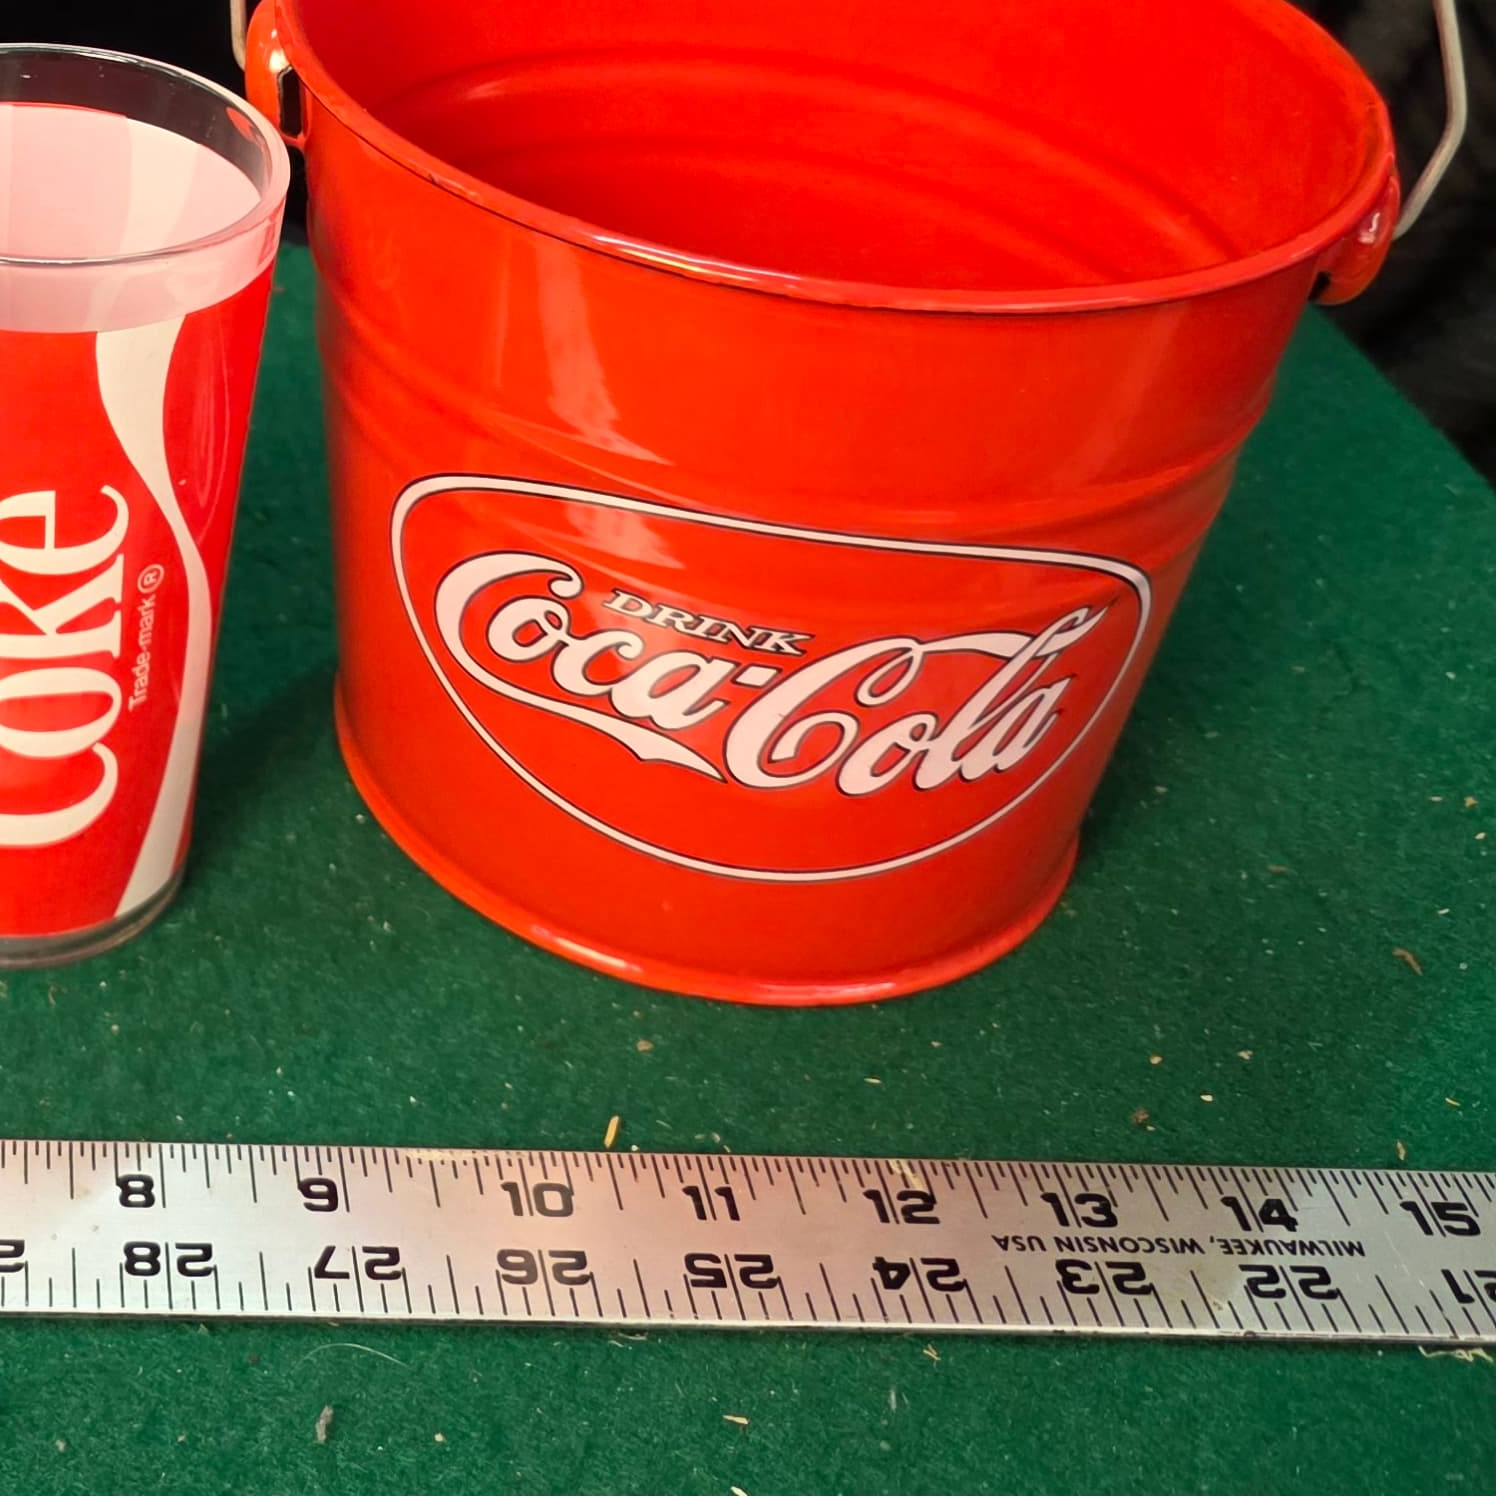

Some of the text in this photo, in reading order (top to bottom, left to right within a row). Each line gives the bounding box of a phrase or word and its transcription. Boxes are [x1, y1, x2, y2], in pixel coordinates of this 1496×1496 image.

[601, 589, 814, 657] DRINK
[128, 594, 156, 710] Trade-mark
[434, 550, 1114, 797] Coca-Cola
[117, 1173, 156, 1208] 8
[298, 1177, 340, 1213] 9
[501, 1181, 574, 1218] 10
[683, 1185, 740, 1221] 11
[863, 1190, 941, 1225] 12
[1041, 1192, 1118, 1228] 13
[1221, 1196, 1299, 1232] 14
[1399, 1201, 1481, 1236] 15
[122, 1241, 215, 1277] 28
[314, 1245, 402, 1281] 27
[991, 1234, 1366, 1257] MILWAUKEE, WISCONSIN USA
[497, 1248, 592, 1285] 26
[684, 1252, 777, 1289] 25
[871, 1256, 966, 1293] 24
[1055, 1259, 1152, 1296] 23
[1239, 1264, 1340, 1300] 22
